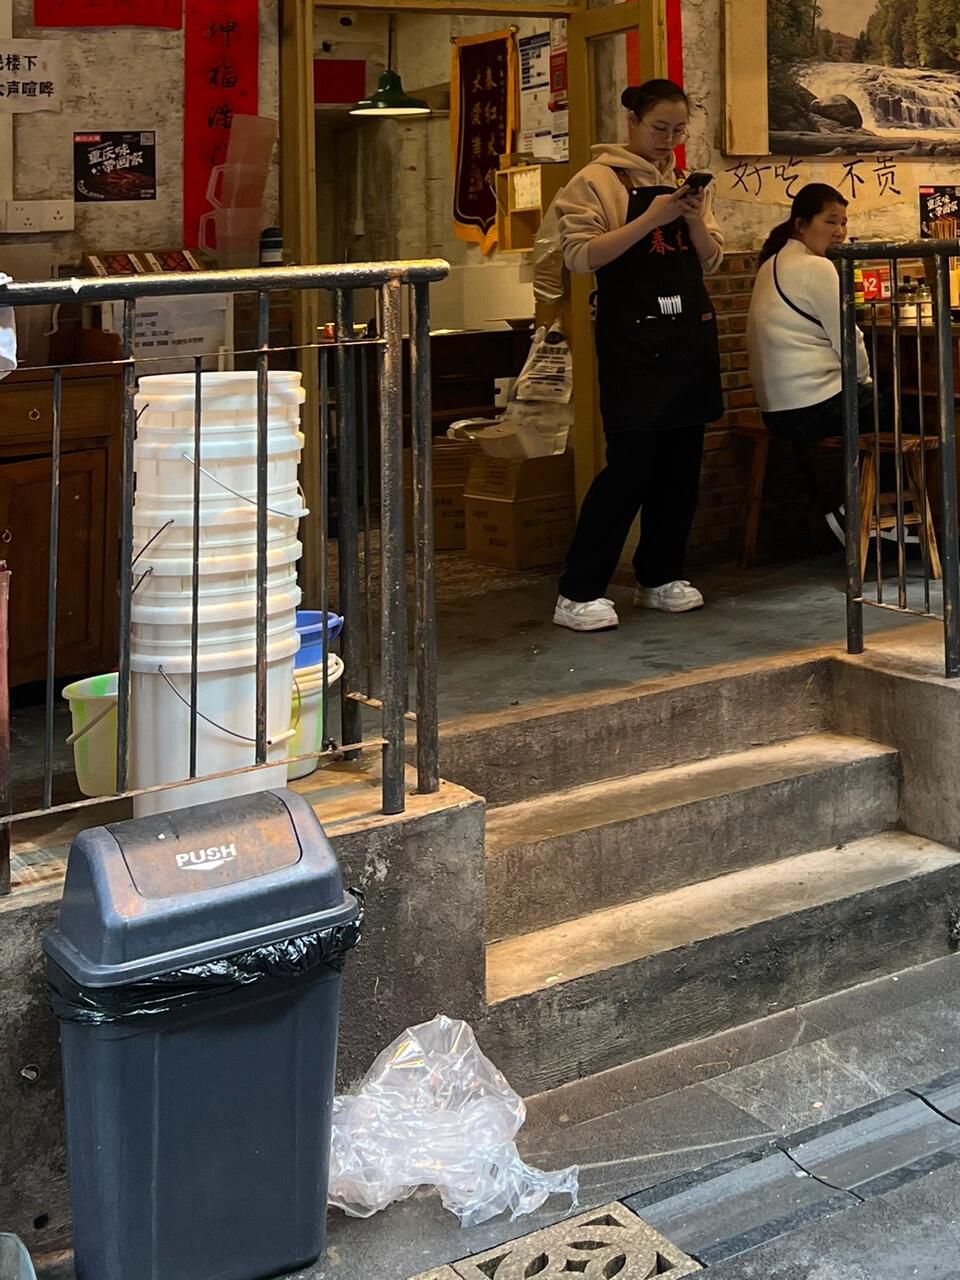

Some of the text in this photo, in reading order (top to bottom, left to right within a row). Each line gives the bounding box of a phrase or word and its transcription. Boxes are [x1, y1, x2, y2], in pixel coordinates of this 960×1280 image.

[0, 54, 38, 71] 楼下
[0, 80, 54, 97] 声喧哗
[88, 143, 130, 165] 重庆味
[102, 151, 143, 173] 带回家
[725, 156, 901, 198] 好吃 不贵
[176, 843, 237, 867] PUSH
